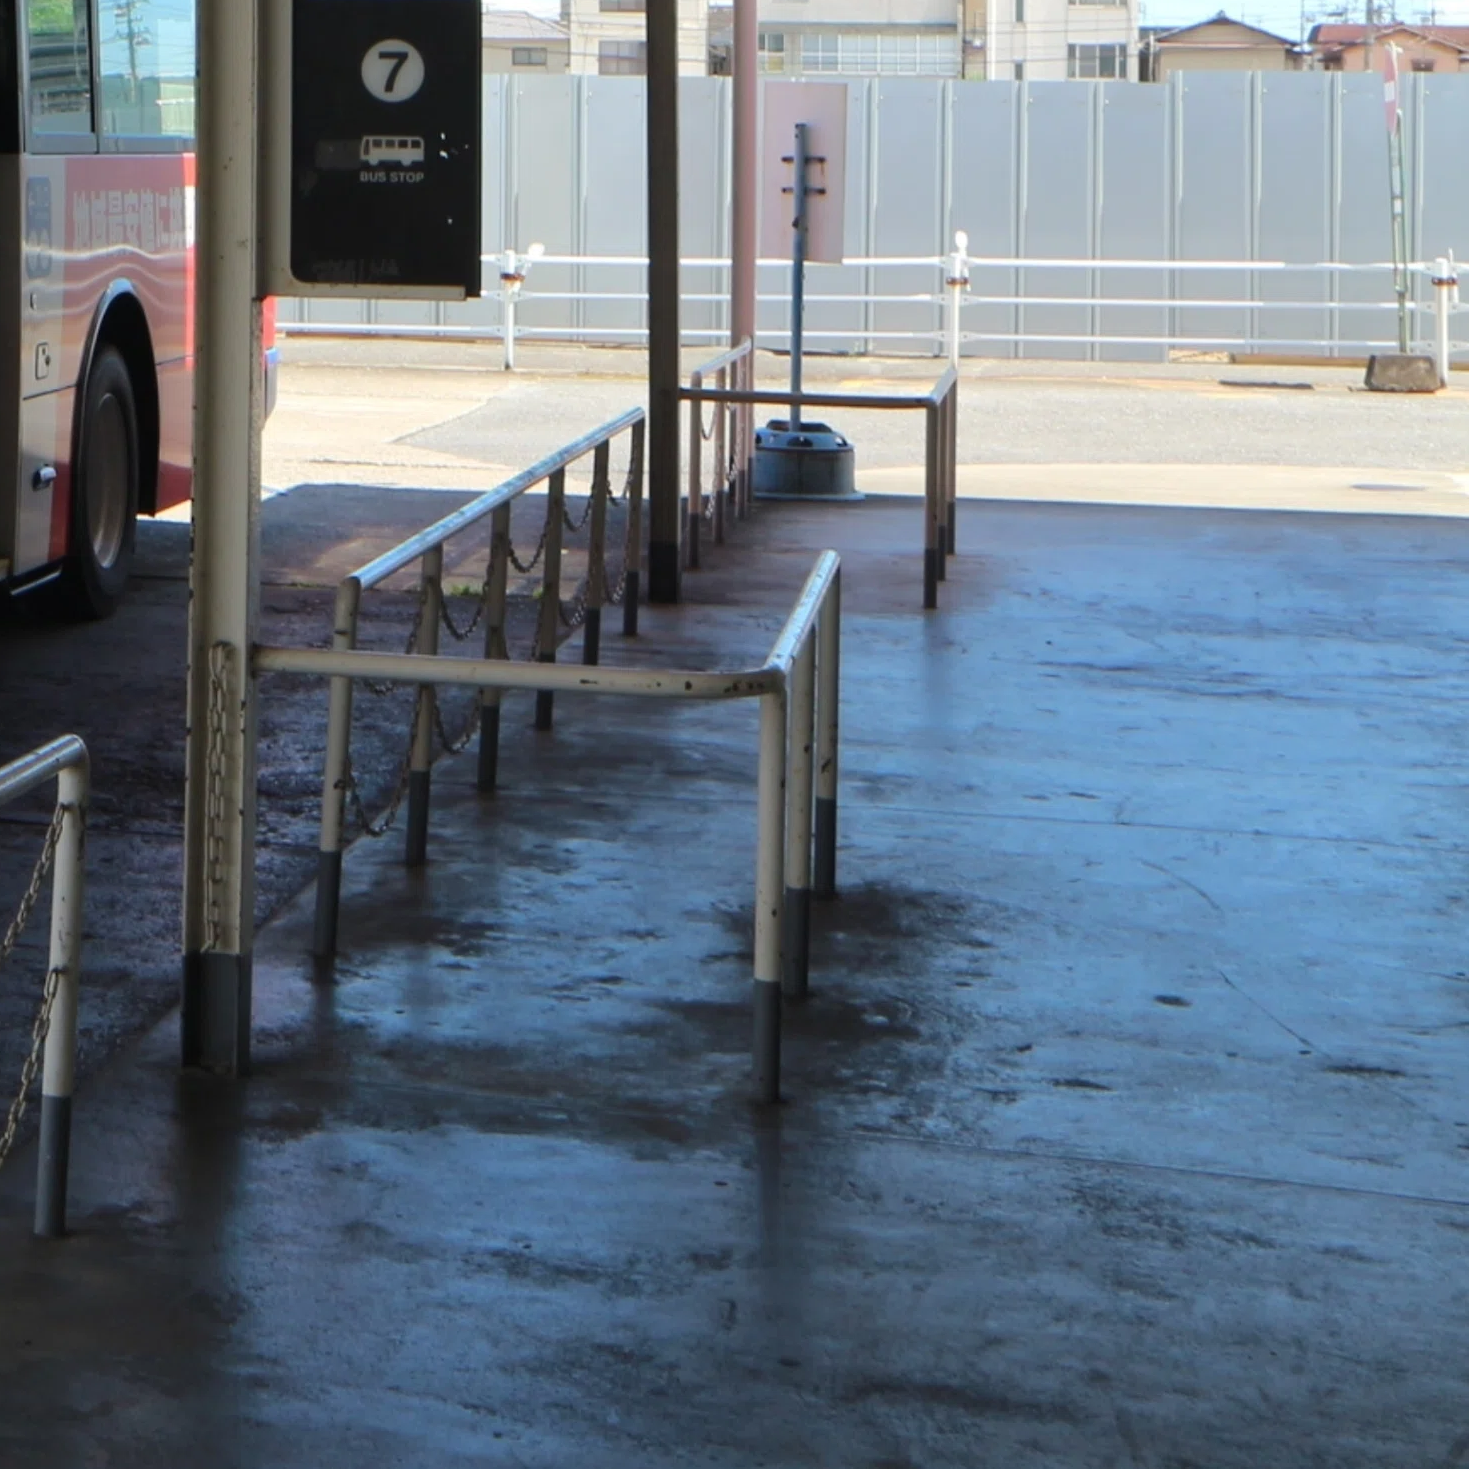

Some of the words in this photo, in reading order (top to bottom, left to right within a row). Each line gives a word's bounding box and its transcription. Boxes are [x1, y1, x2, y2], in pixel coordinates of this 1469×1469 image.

[377, 51, 409, 93] 7
[360, 171, 387, 183] BUS
[389, 172, 425, 183] STOP
